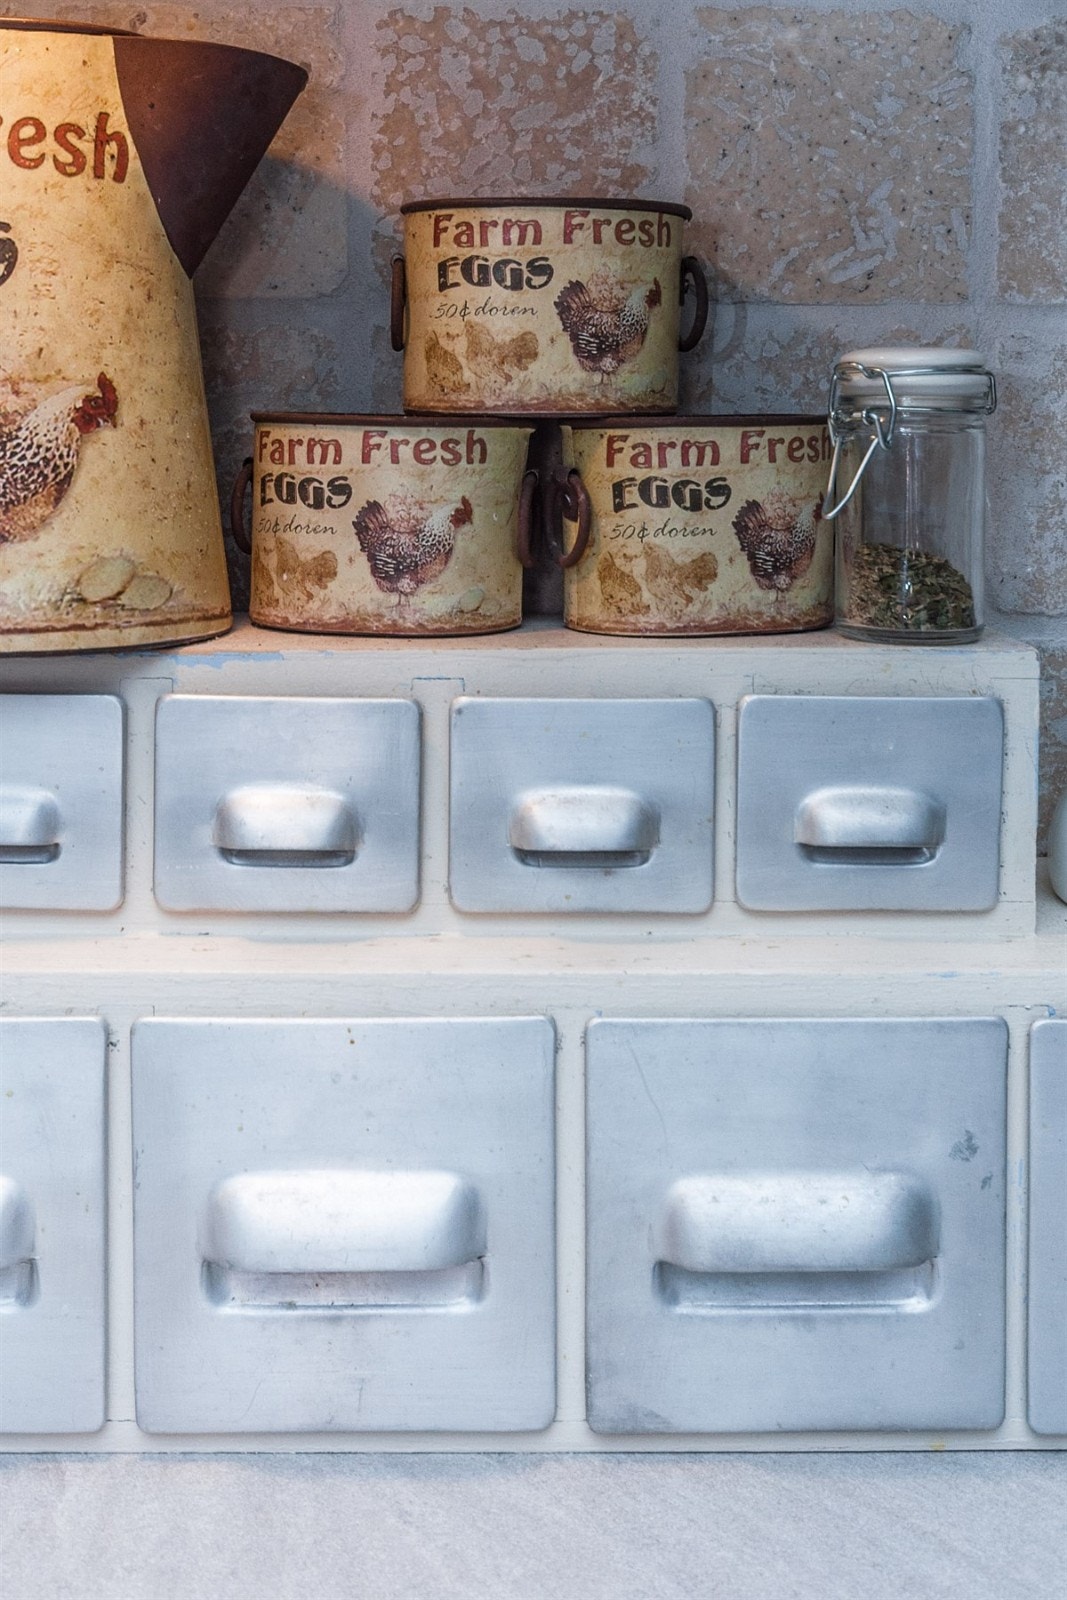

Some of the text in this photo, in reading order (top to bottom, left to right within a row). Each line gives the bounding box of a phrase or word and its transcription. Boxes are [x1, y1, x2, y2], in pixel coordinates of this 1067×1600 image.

[0, 112, 129, 184] esh
[433, 210, 671, 248] Farm Fresh
[437, 254, 554, 293] EGGS
[258, 429, 488, 466] Farm Fresh
[606, 427, 832, 469] Farm Fresh
[260, 471, 353, 510] EGGS
[612, 475, 732, 513] EGGS
